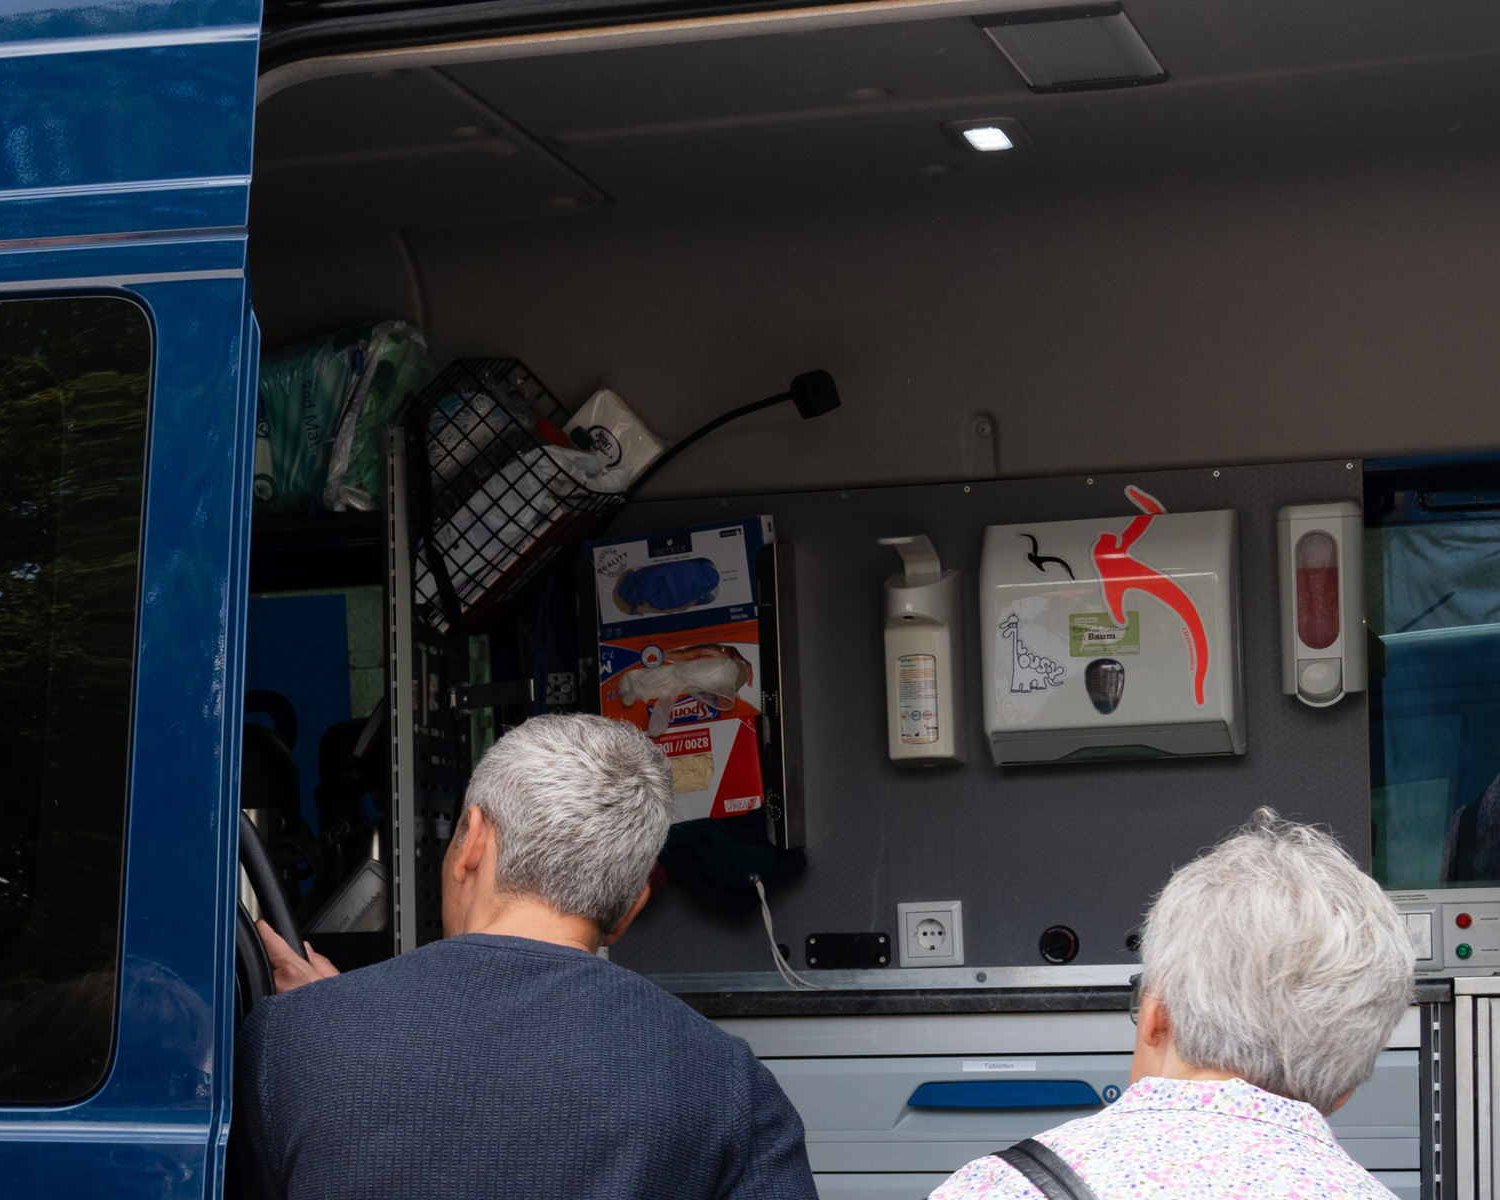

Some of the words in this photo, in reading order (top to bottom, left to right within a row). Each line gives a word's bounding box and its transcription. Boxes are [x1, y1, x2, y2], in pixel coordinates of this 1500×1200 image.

[595, 430, 613, 450] Jean
[653, 544, 687, 556] MATRIX
[597, 551, 628, 574] QUALITY
[729, 605, 743, 614] Blue
[669, 702, 708, 721] Spont
[684, 736, 709, 750] 8200
[983, 1062, 1014, 1070] Tabletten
